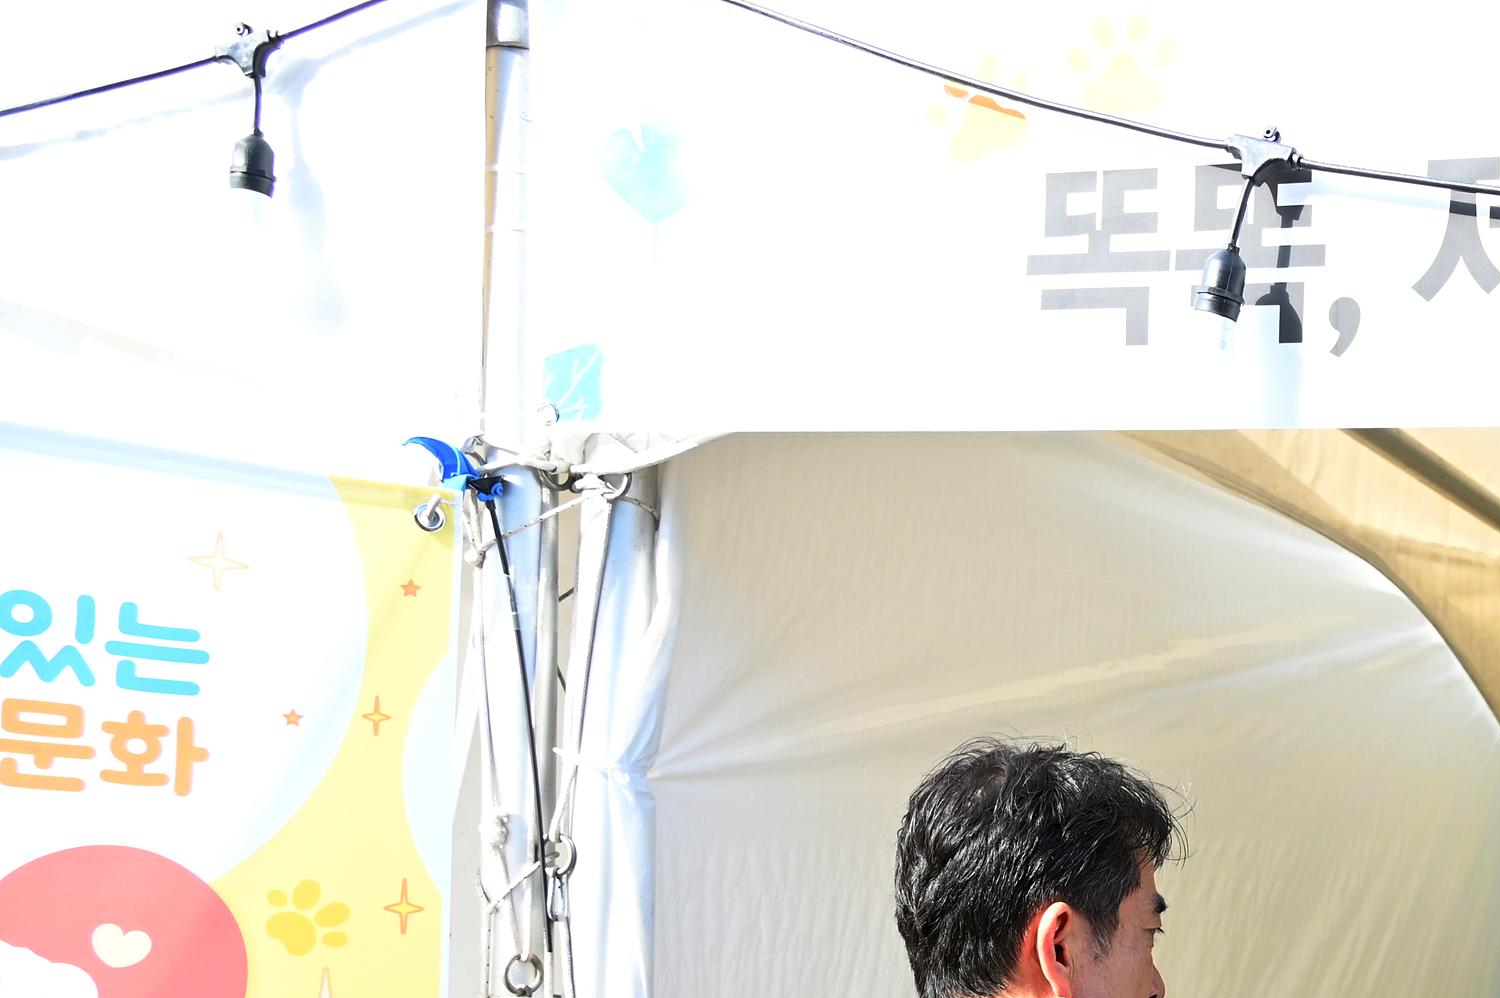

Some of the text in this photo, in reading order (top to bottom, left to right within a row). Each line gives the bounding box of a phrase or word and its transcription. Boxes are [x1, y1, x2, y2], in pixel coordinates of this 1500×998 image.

[1027, 163, 1362, 358] 똑똑,
[0, 589, 210, 696] 있는
[0, 698, 210, 797] 문화
